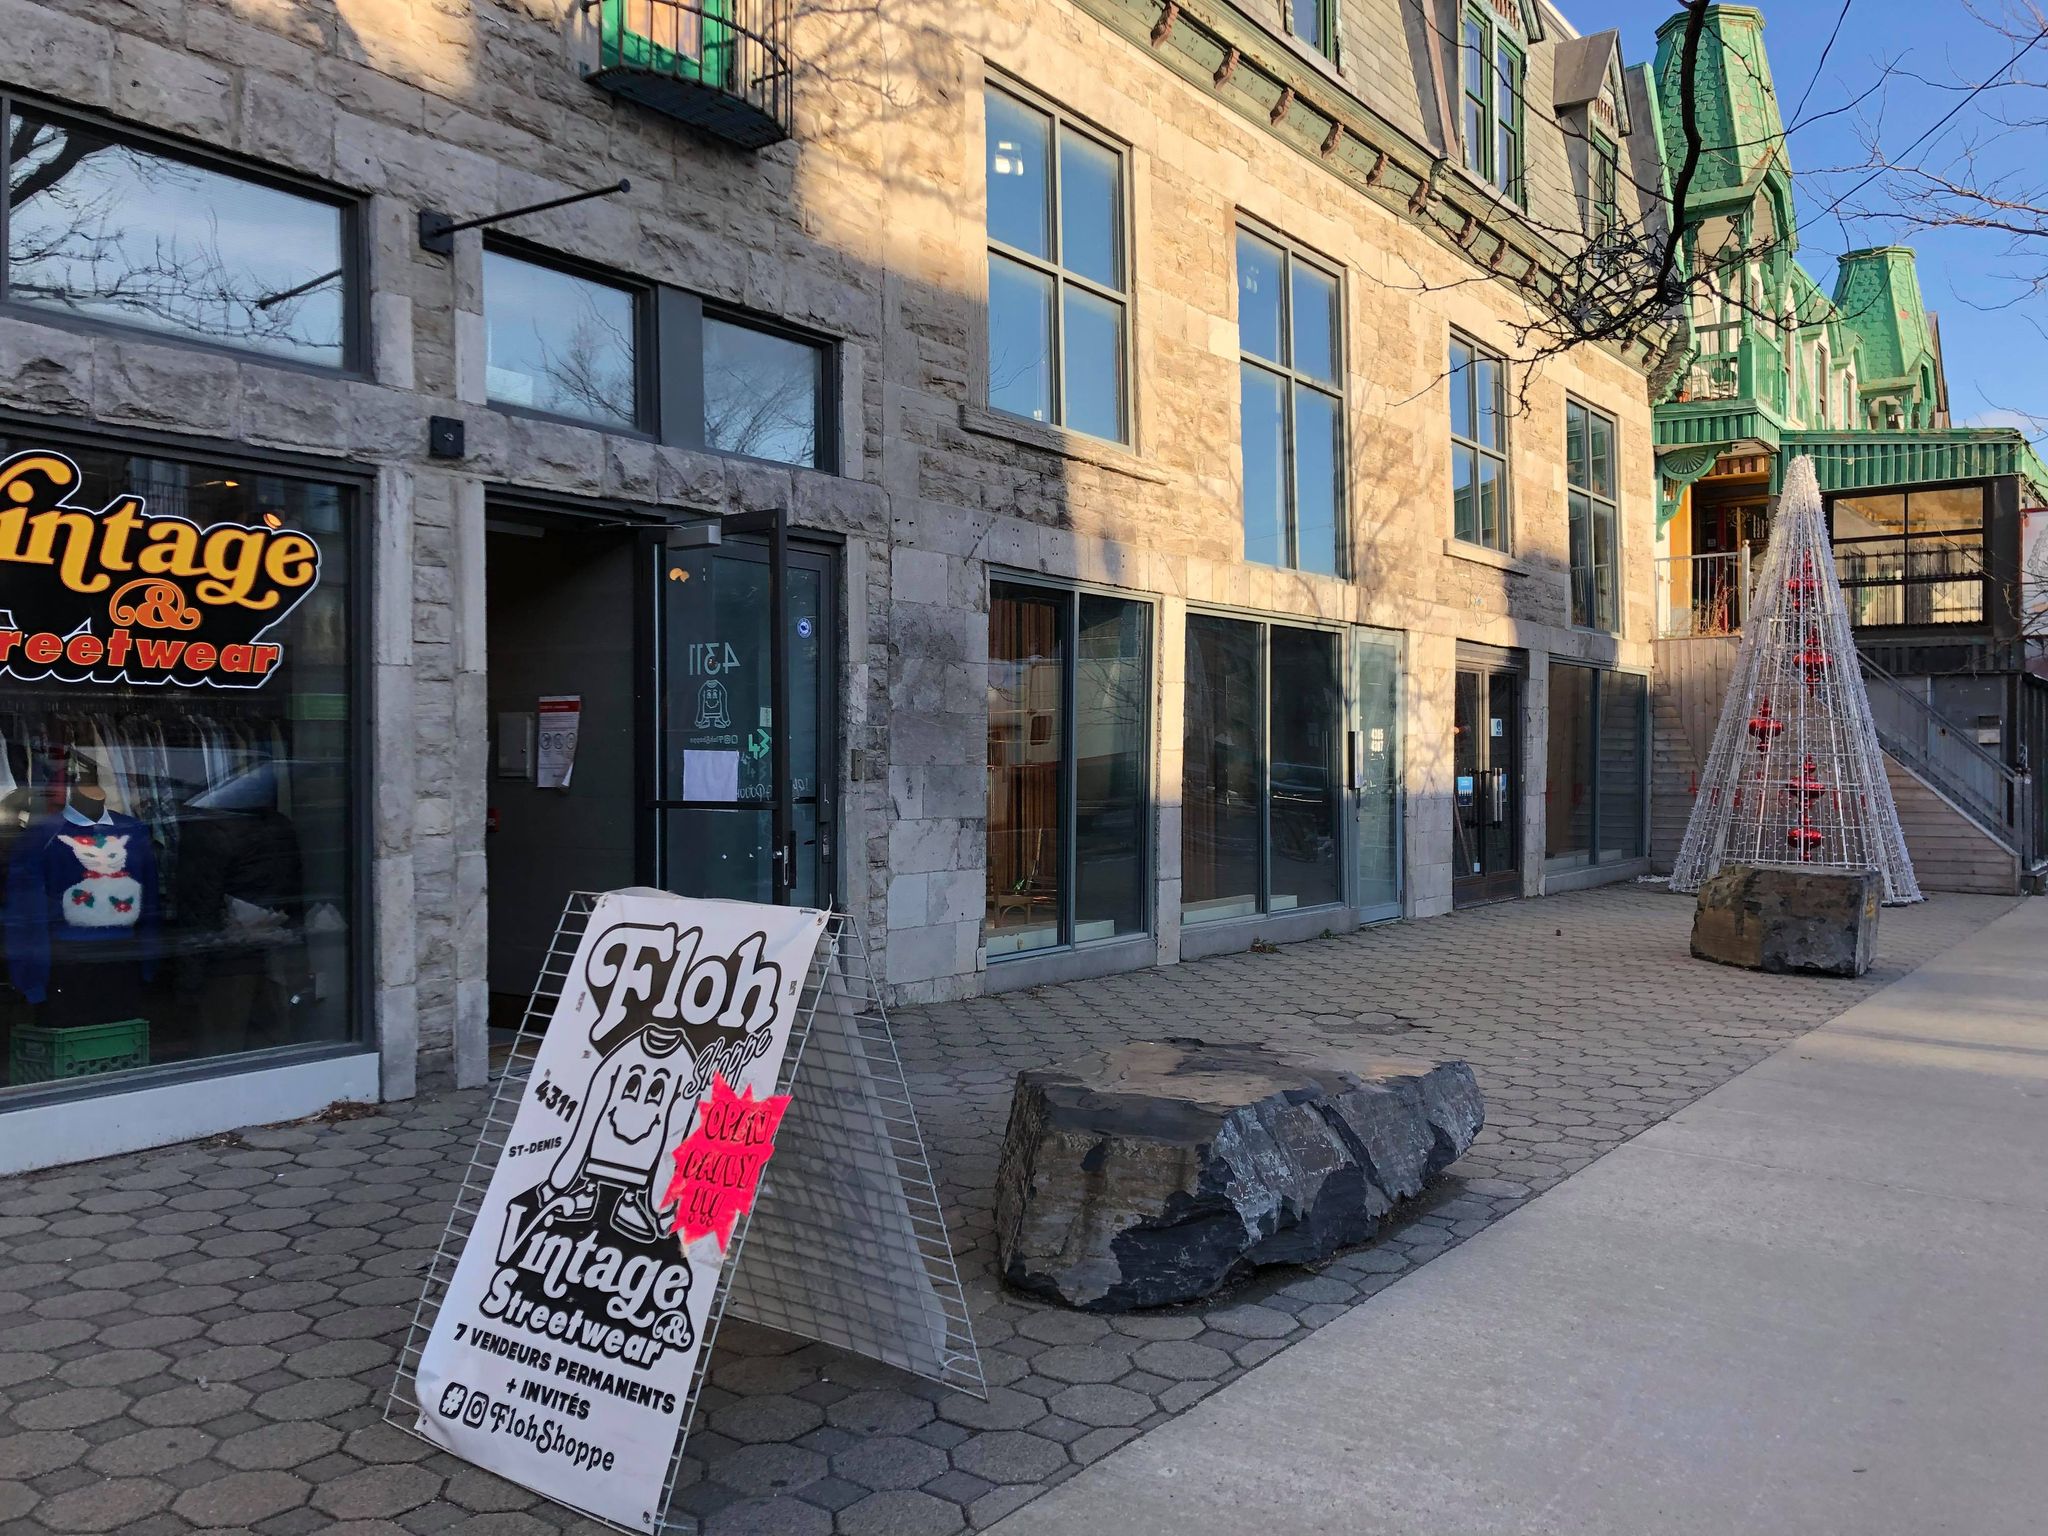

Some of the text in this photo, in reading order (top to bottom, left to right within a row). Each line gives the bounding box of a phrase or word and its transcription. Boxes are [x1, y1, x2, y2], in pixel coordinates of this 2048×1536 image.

[109, 578, 203, 631] &
[586, 922, 781, 1042] Floh
[684, 1029, 773, 1099] Shoppe
[534, 1079, 579, 1123] 4311
[705, 1101, 771, 1146] OPEN
[508, 1136, 563, 1158] ST-DENIS
[683, 1150, 758, 1189] DAILY
[498, 1196, 692, 1349] Vintage &
[482, 1268, 666, 1367] Streetwear
[453, 1323, 677, 1415] 7 VENDEURS PERMANENTS
[520, 1379, 591, 1420] INVITÉS
[490, 1402, 615, 1472] FlohShoppe
